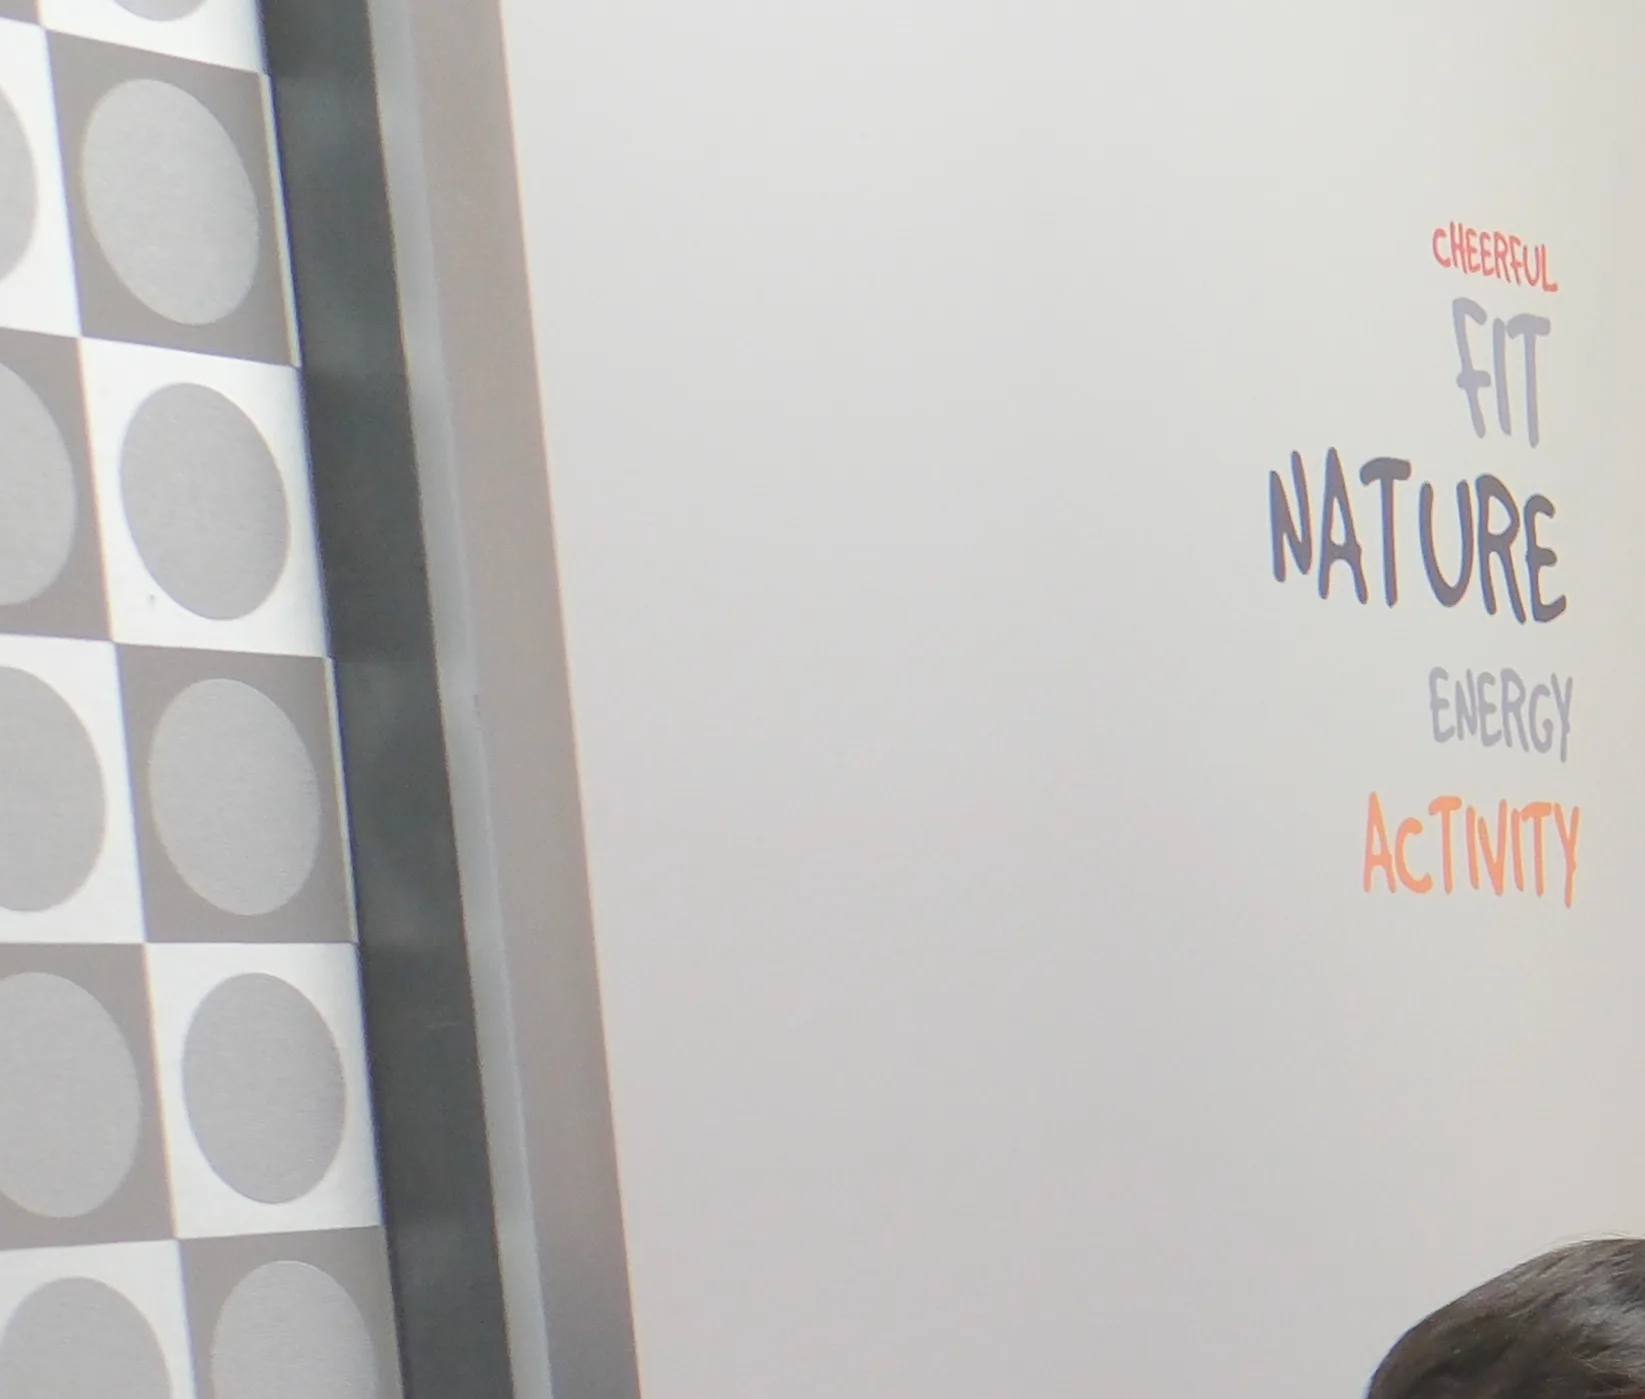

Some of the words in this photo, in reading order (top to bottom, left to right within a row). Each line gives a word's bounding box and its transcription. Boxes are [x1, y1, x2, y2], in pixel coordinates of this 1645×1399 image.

[1432, 221, 1559, 292] CHEERFUL
[1451, 297, 1552, 448] FIT
[1268, 446, 1568, 625] NATURE
[1428, 665, 1574, 764] ENERGY
[1362, 791, 1580, 908] ACTIVITY
